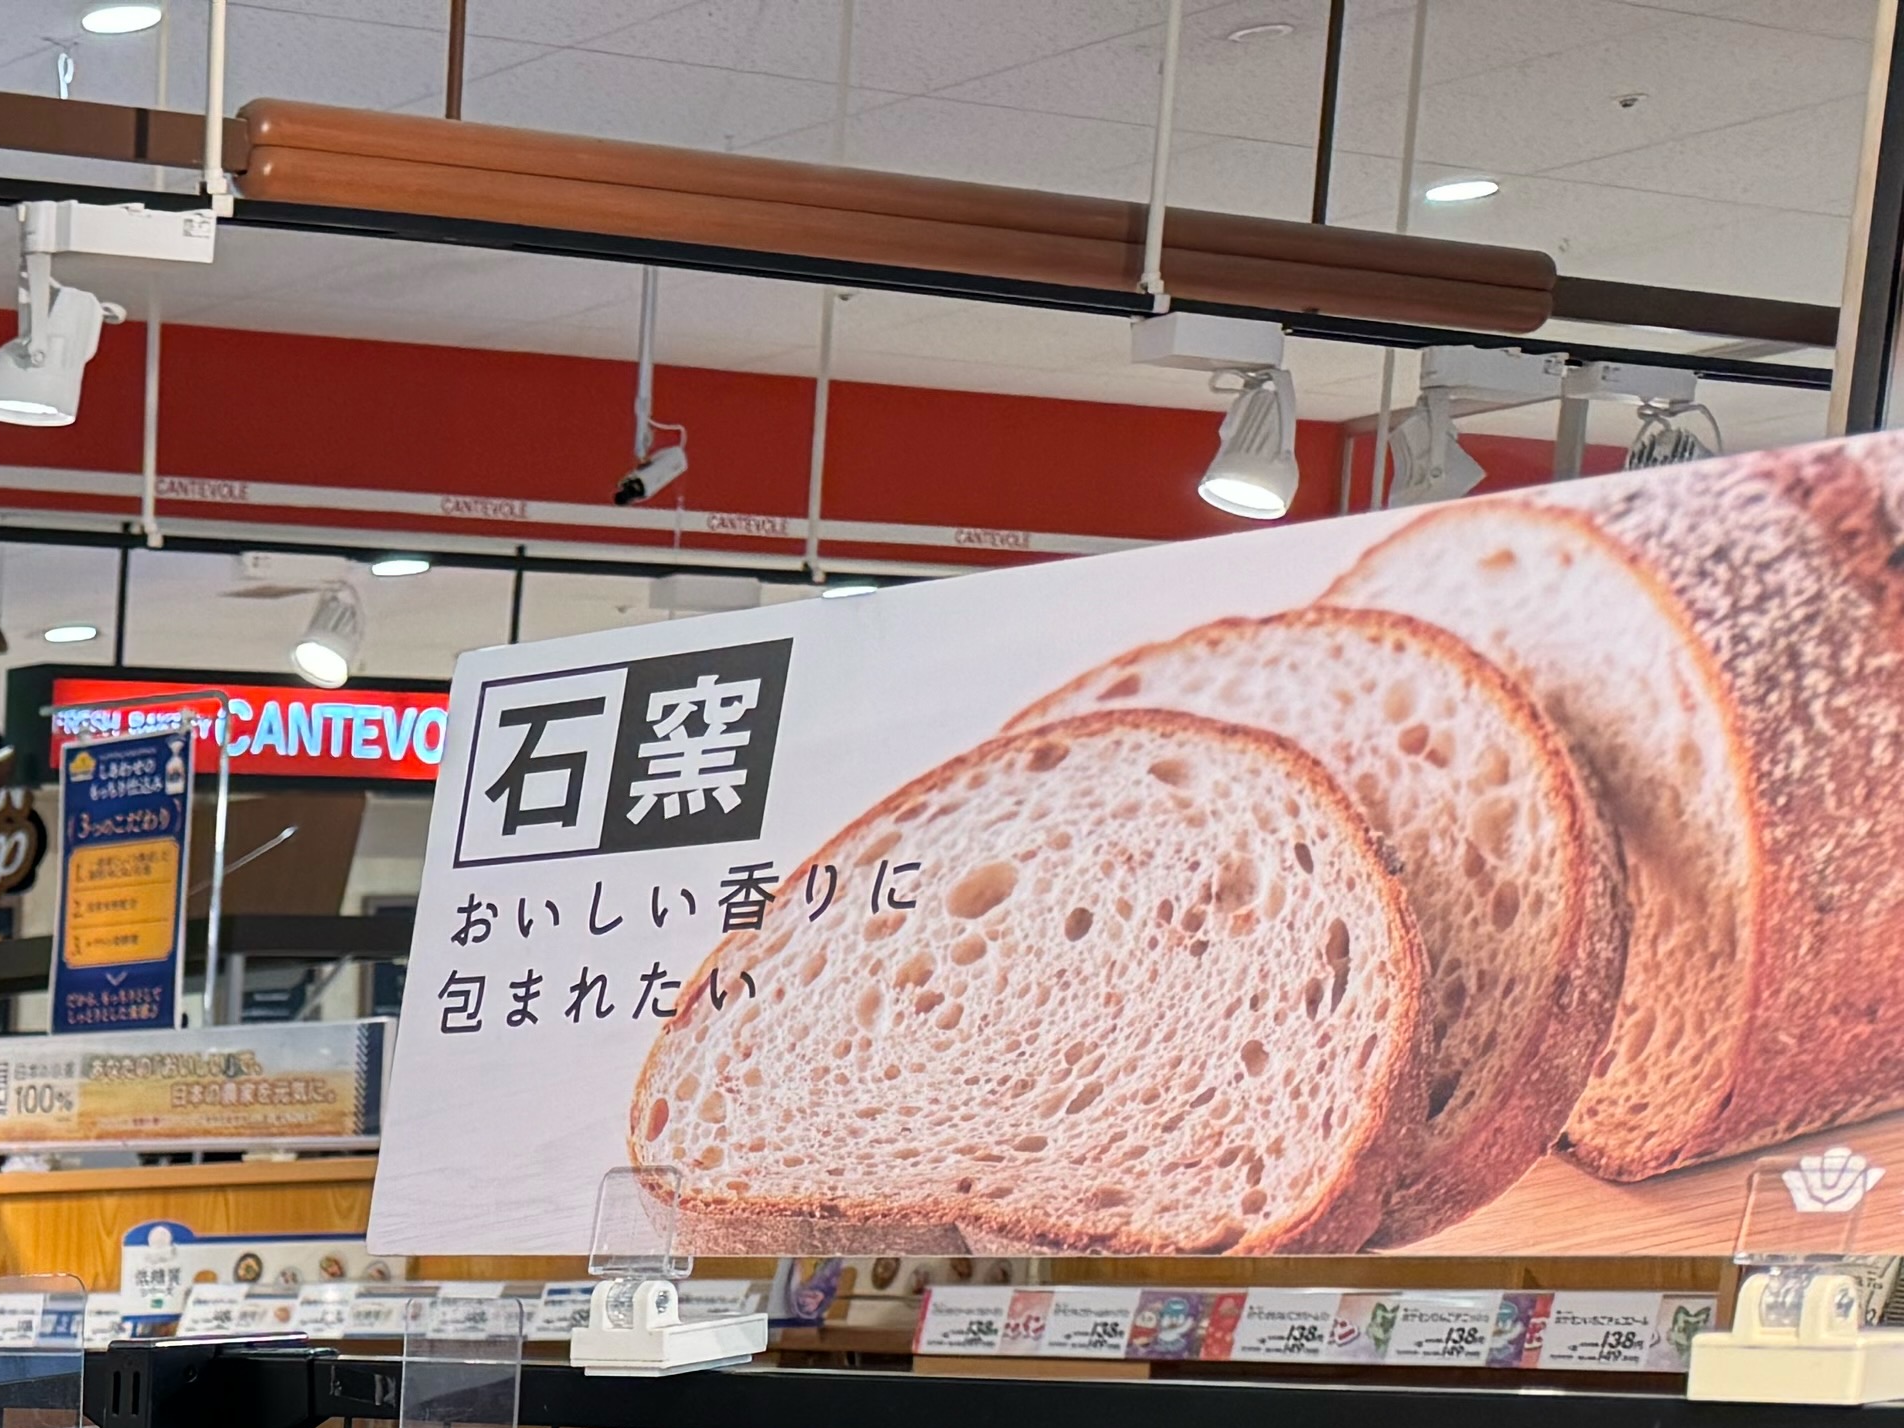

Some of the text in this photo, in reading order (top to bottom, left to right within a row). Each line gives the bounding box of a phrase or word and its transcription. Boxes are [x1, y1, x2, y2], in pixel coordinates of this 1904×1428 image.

[153, 479, 250, 501] CANTEVOLE
[440, 496, 530, 519] CANTEVOLE
[486, 675, 761, 836] 石窯
[450, 859, 922, 947] おいしい香りに
[437, 959, 758, 1034] 包まれたい
[15, 1085, 73, 1114] 100%
